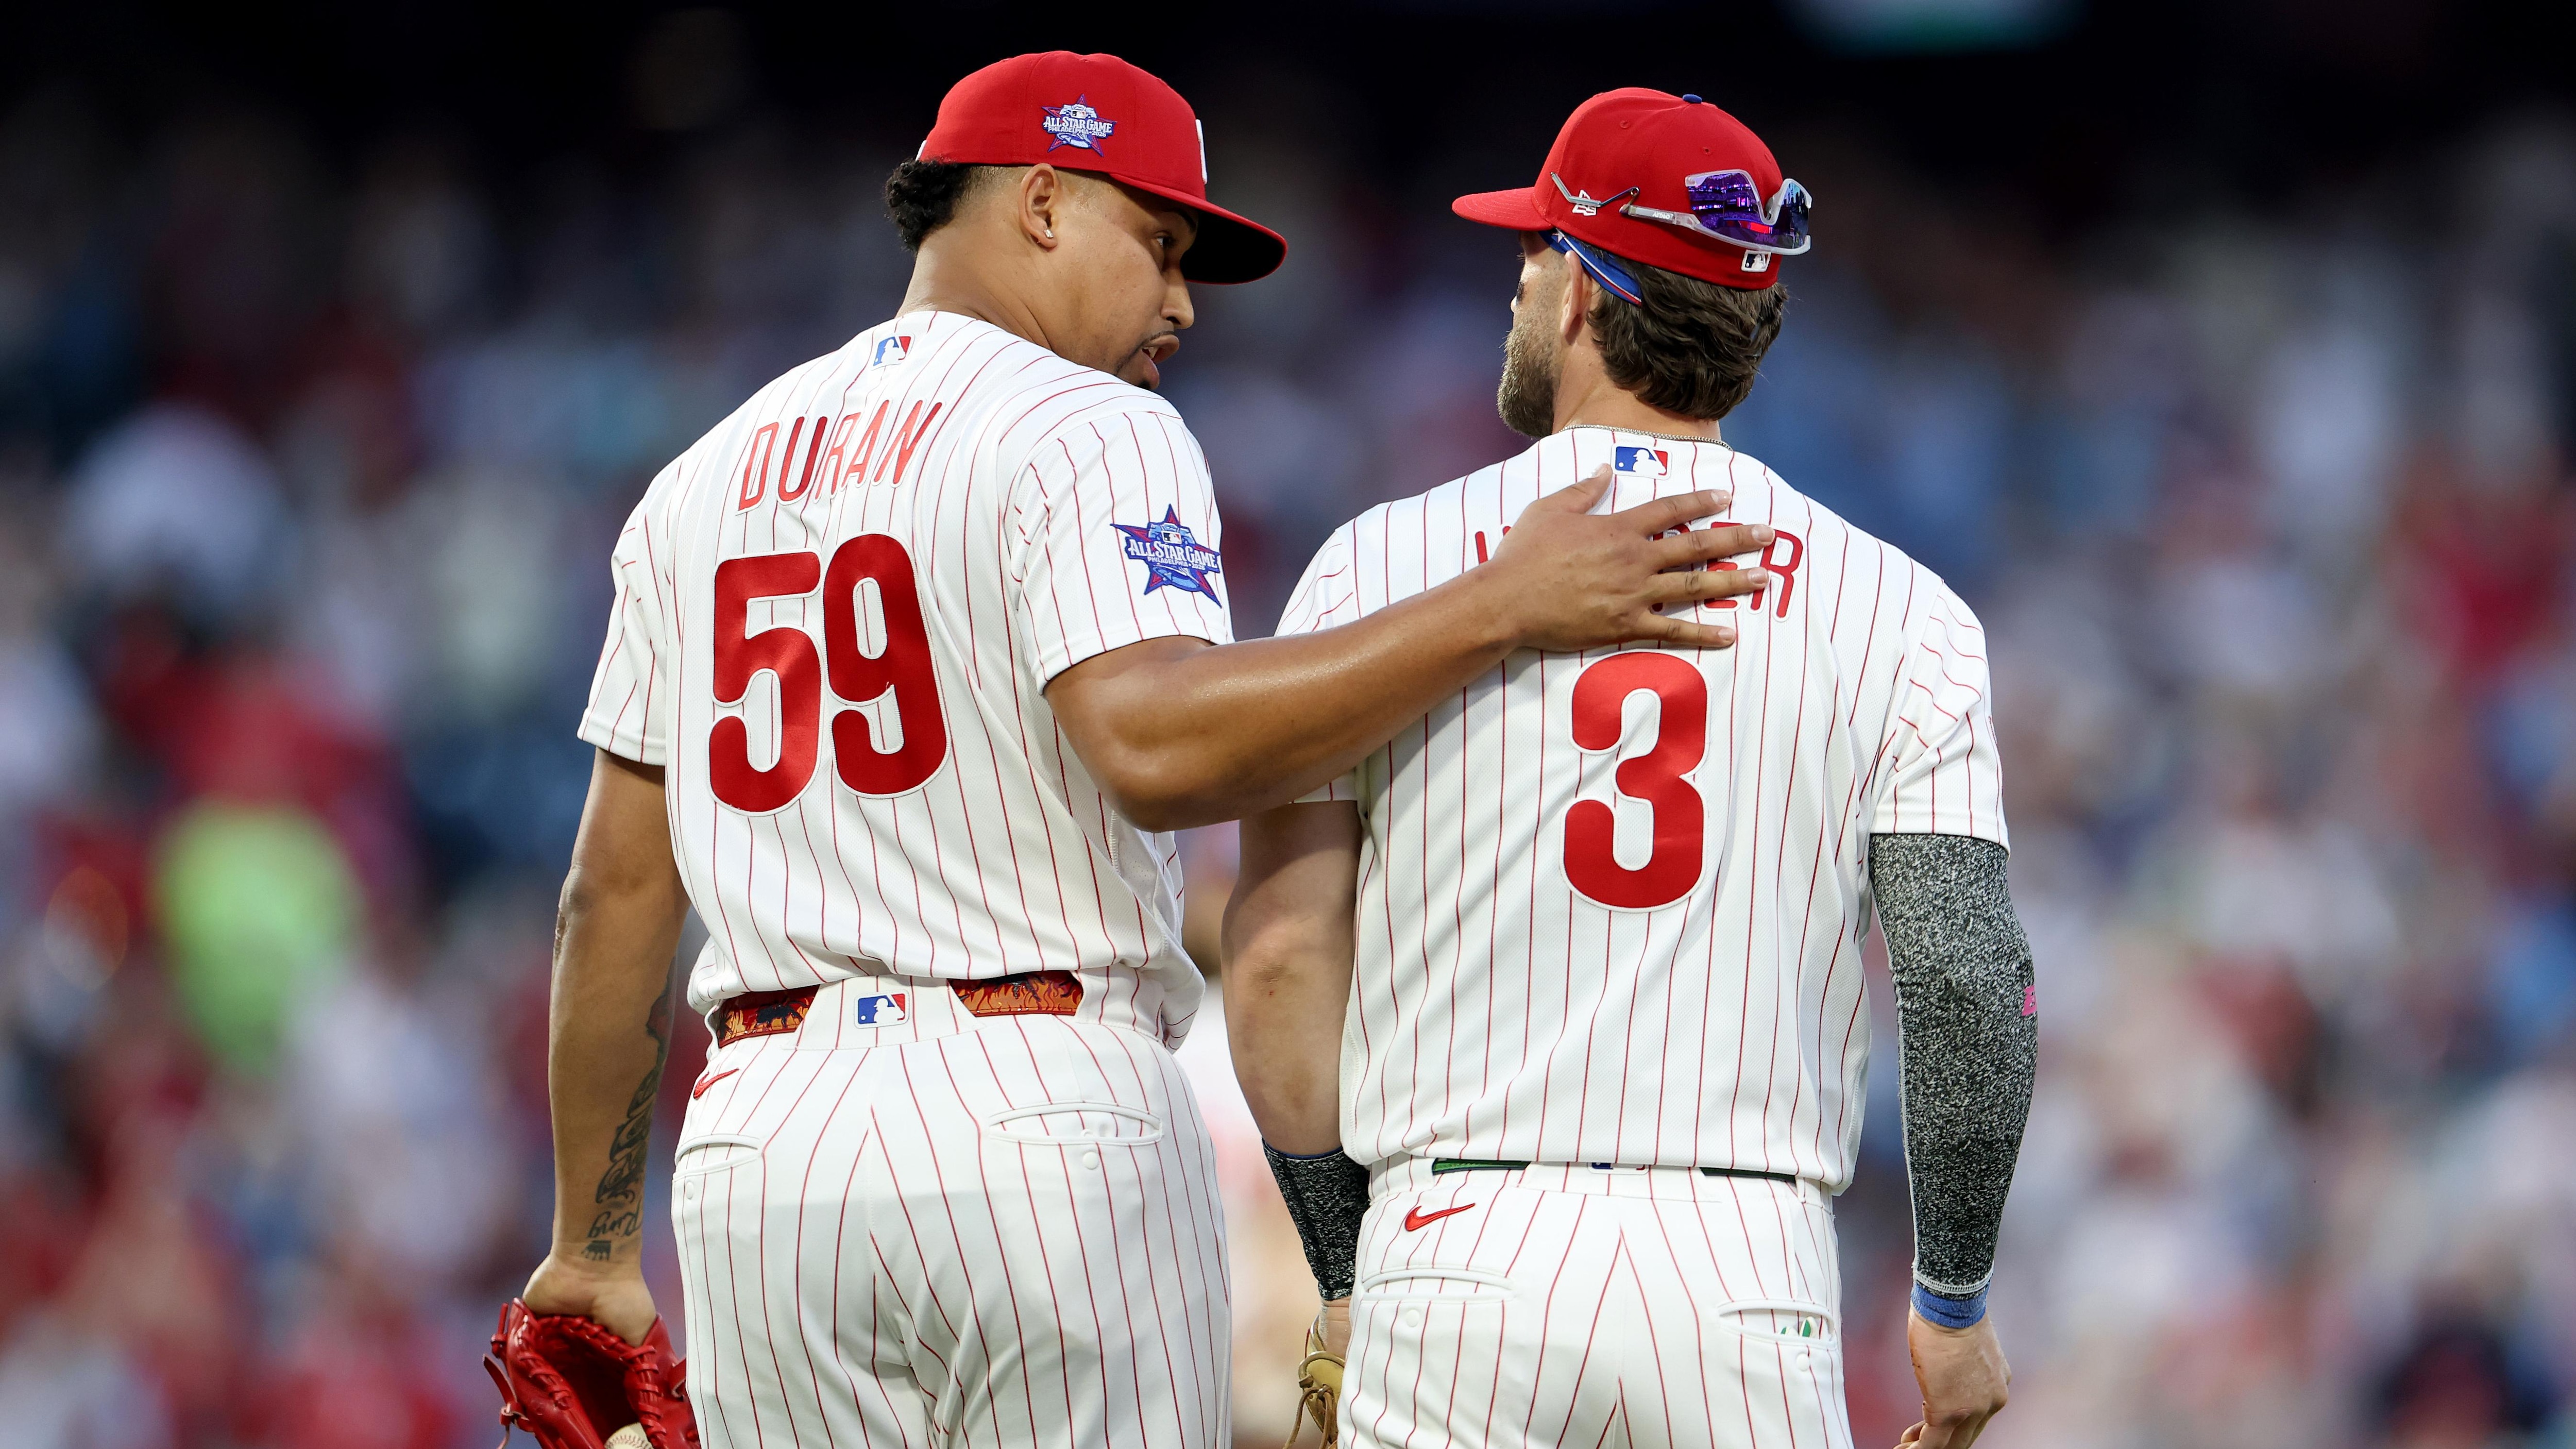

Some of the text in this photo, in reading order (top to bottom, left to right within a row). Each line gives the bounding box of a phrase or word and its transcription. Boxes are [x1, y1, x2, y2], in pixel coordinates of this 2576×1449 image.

[1043, 116, 1112, 133] ALL STAR GAME
[737, 399, 944, 512] DURAN
[1128, 539, 1217, 568] ALL STAR GAME
[1147, 556, 1188, 567] PHILADELPHIA
[709, 532, 947, 813] 59
[1563, 651, 1708, 909] 3
